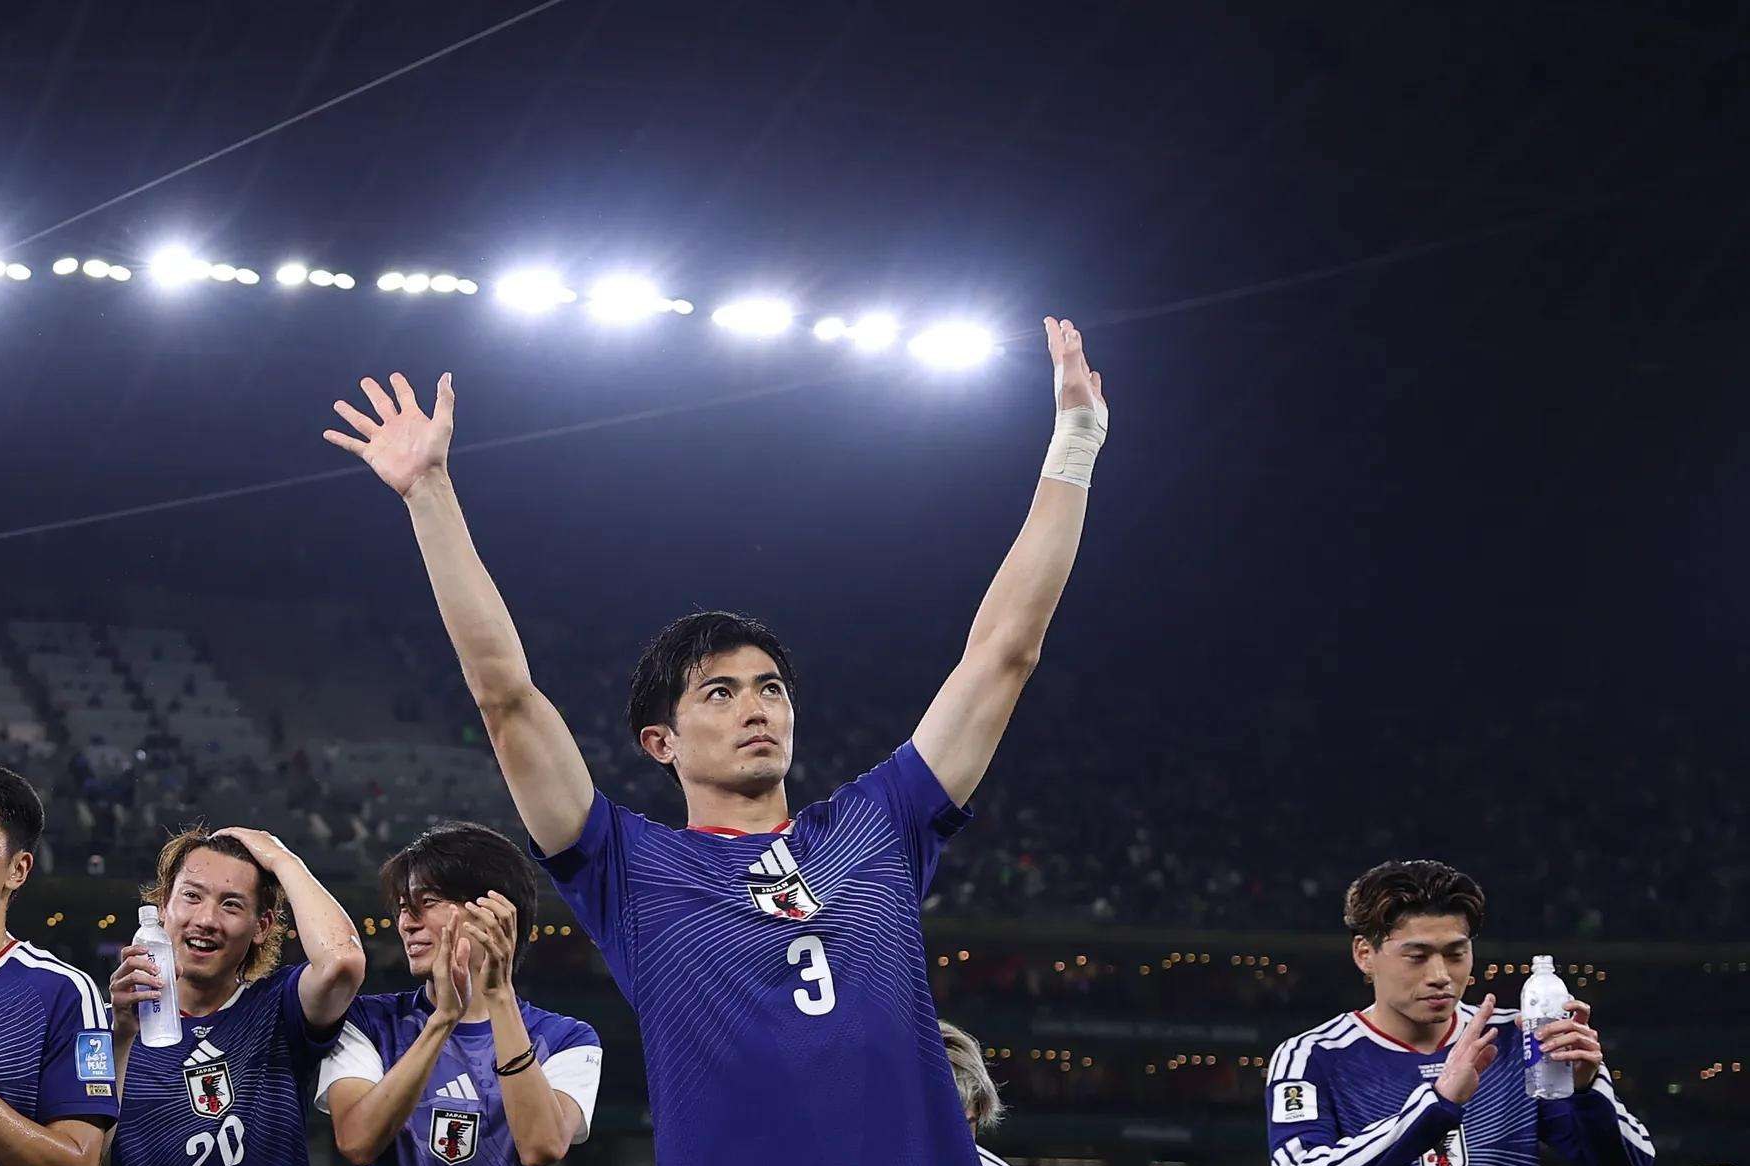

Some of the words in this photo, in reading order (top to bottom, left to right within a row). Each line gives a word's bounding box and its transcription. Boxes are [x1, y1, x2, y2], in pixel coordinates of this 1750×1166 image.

[761, 881, 789, 893] JAPAN
[787, 935, 836, 1016] 3
[194, 1066, 217, 1075] JAPAN
[441, 1147, 461, 1157] JA
